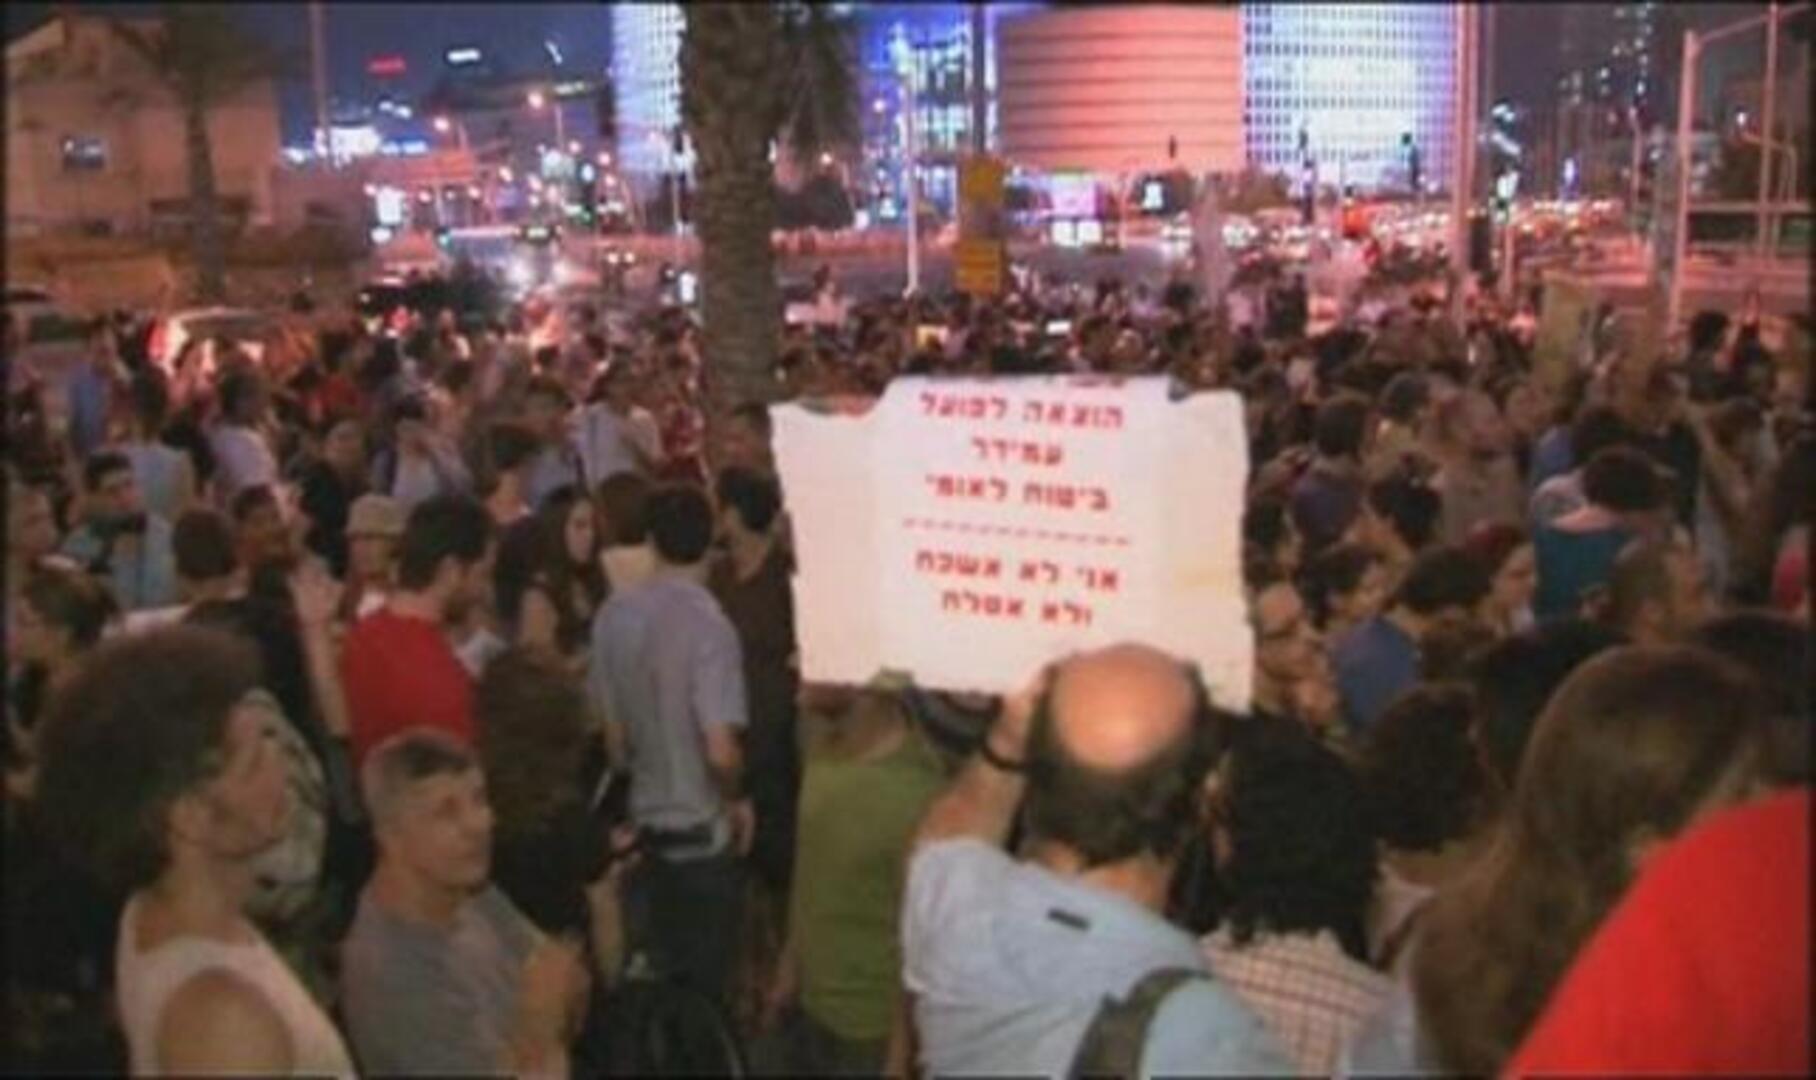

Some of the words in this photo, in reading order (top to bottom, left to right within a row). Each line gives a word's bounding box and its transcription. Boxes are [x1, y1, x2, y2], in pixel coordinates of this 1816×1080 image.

[915, 549, 1001, 577] אשכח
[1019, 560, 1060, 584] לא
[1077, 565, 1118, 591] אני
[942, 589, 1024, 617] אסלח
[1042, 600, 1092, 627] ולא
